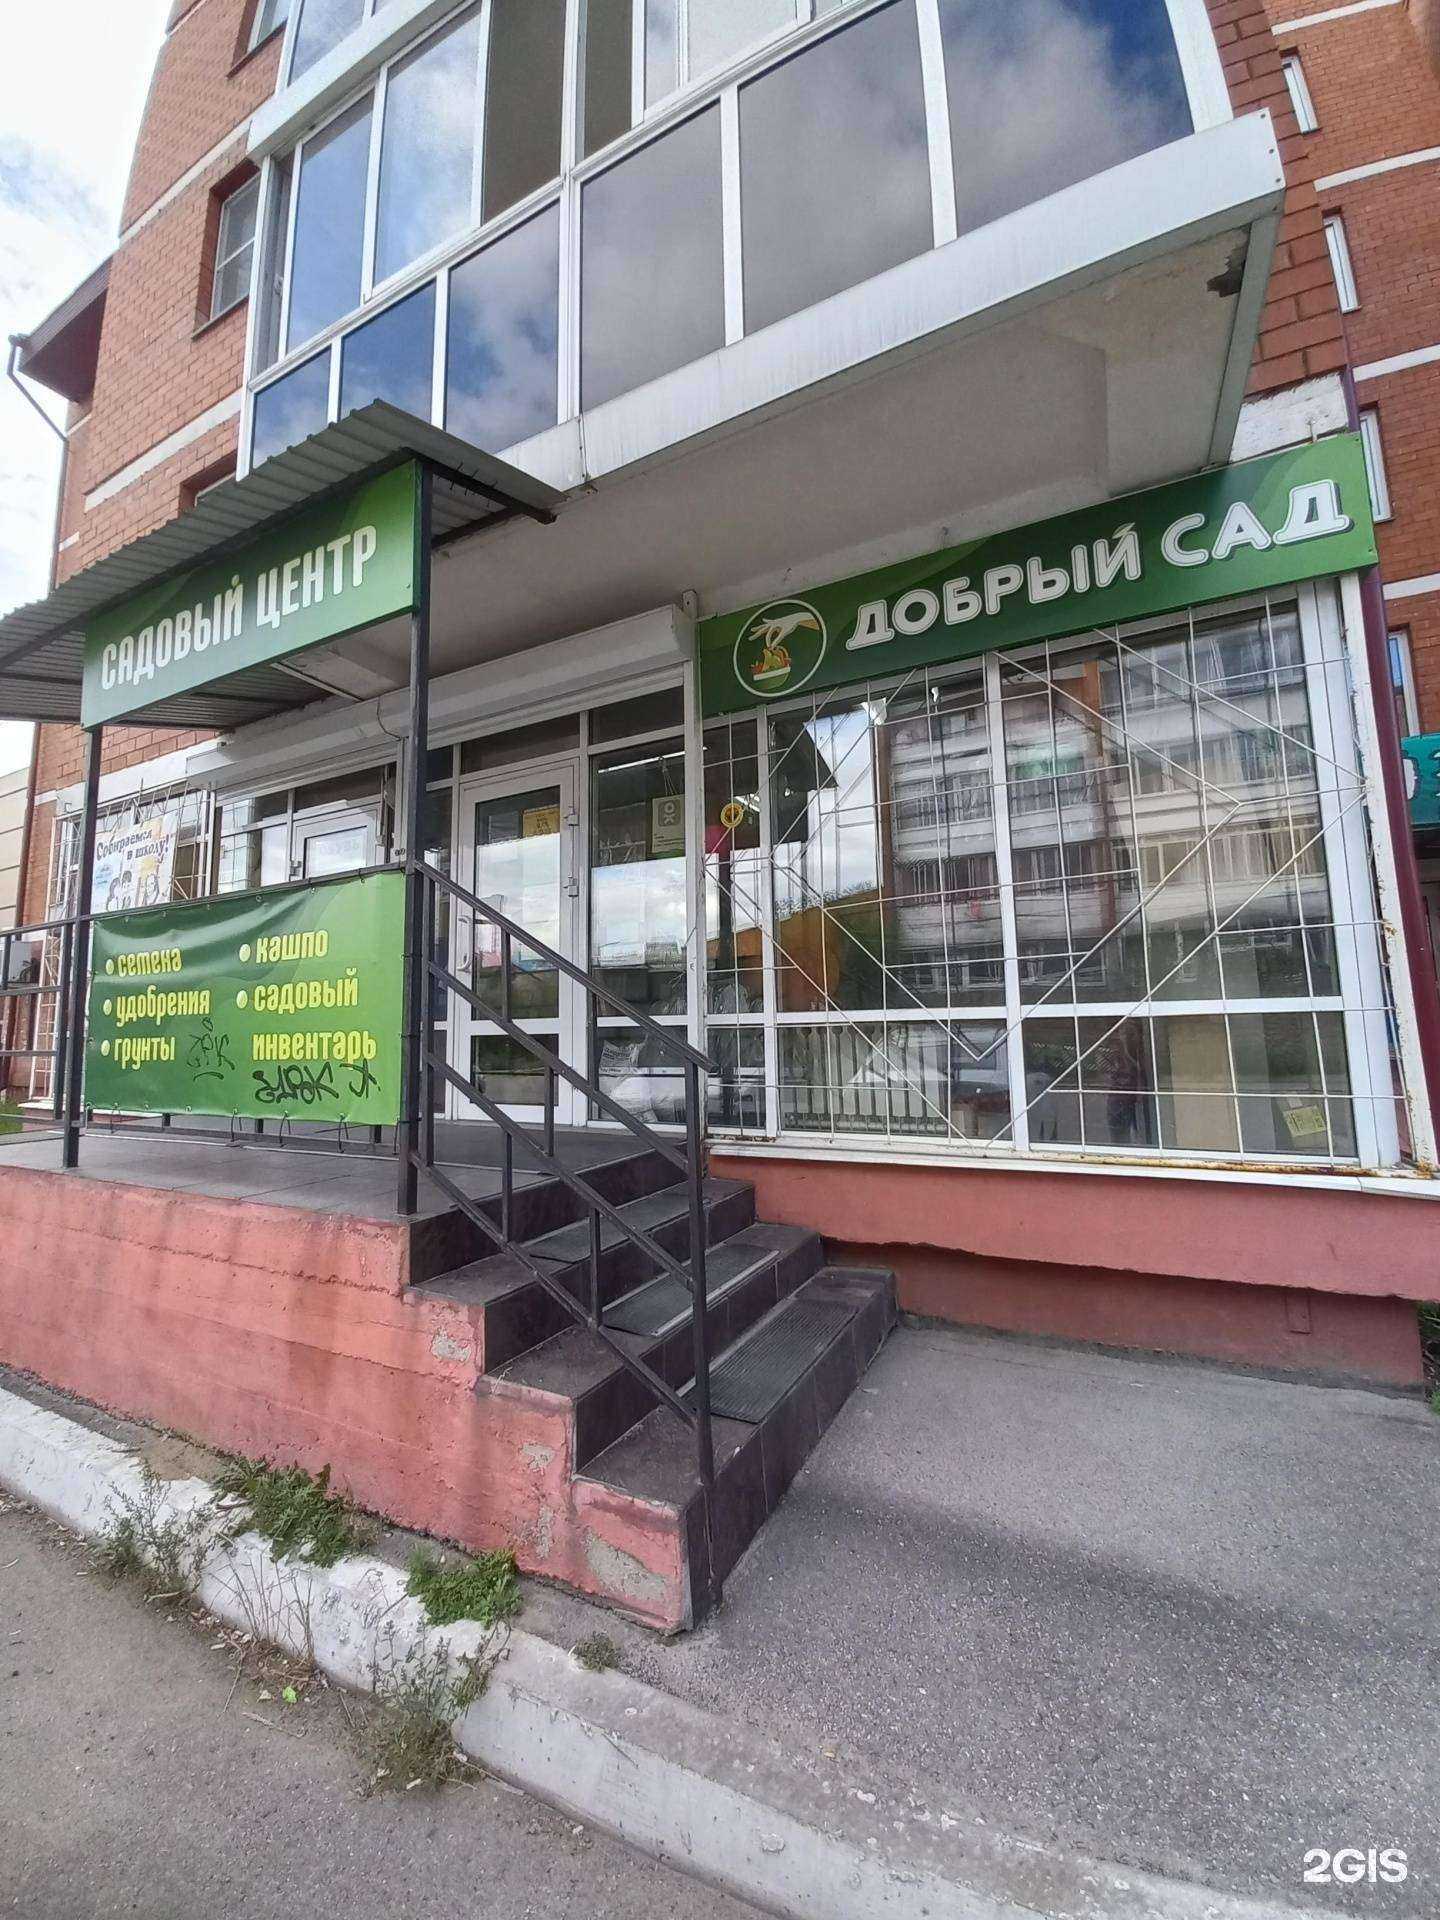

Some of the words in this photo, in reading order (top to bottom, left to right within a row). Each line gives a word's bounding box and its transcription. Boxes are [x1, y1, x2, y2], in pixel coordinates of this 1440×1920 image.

[845, 523, 1142, 651] ДОБРЫЙ
[1161, 478, 1353, 568] САД
[101, 574, 244, 691] САДОВЫЙ
[256, 525, 378, 629] ЦЕНТР
[135, 834, 170, 857] школу!
[117, 948, 183, 978] семена
[255, 929, 329, 964] кашпо
[115, 984, 211, 1028] удобрения
[253, 967, 359, 1014] садовый
[113, 1036, 176, 1071] грунты
[252, 1030, 377, 1071] инвентарь
